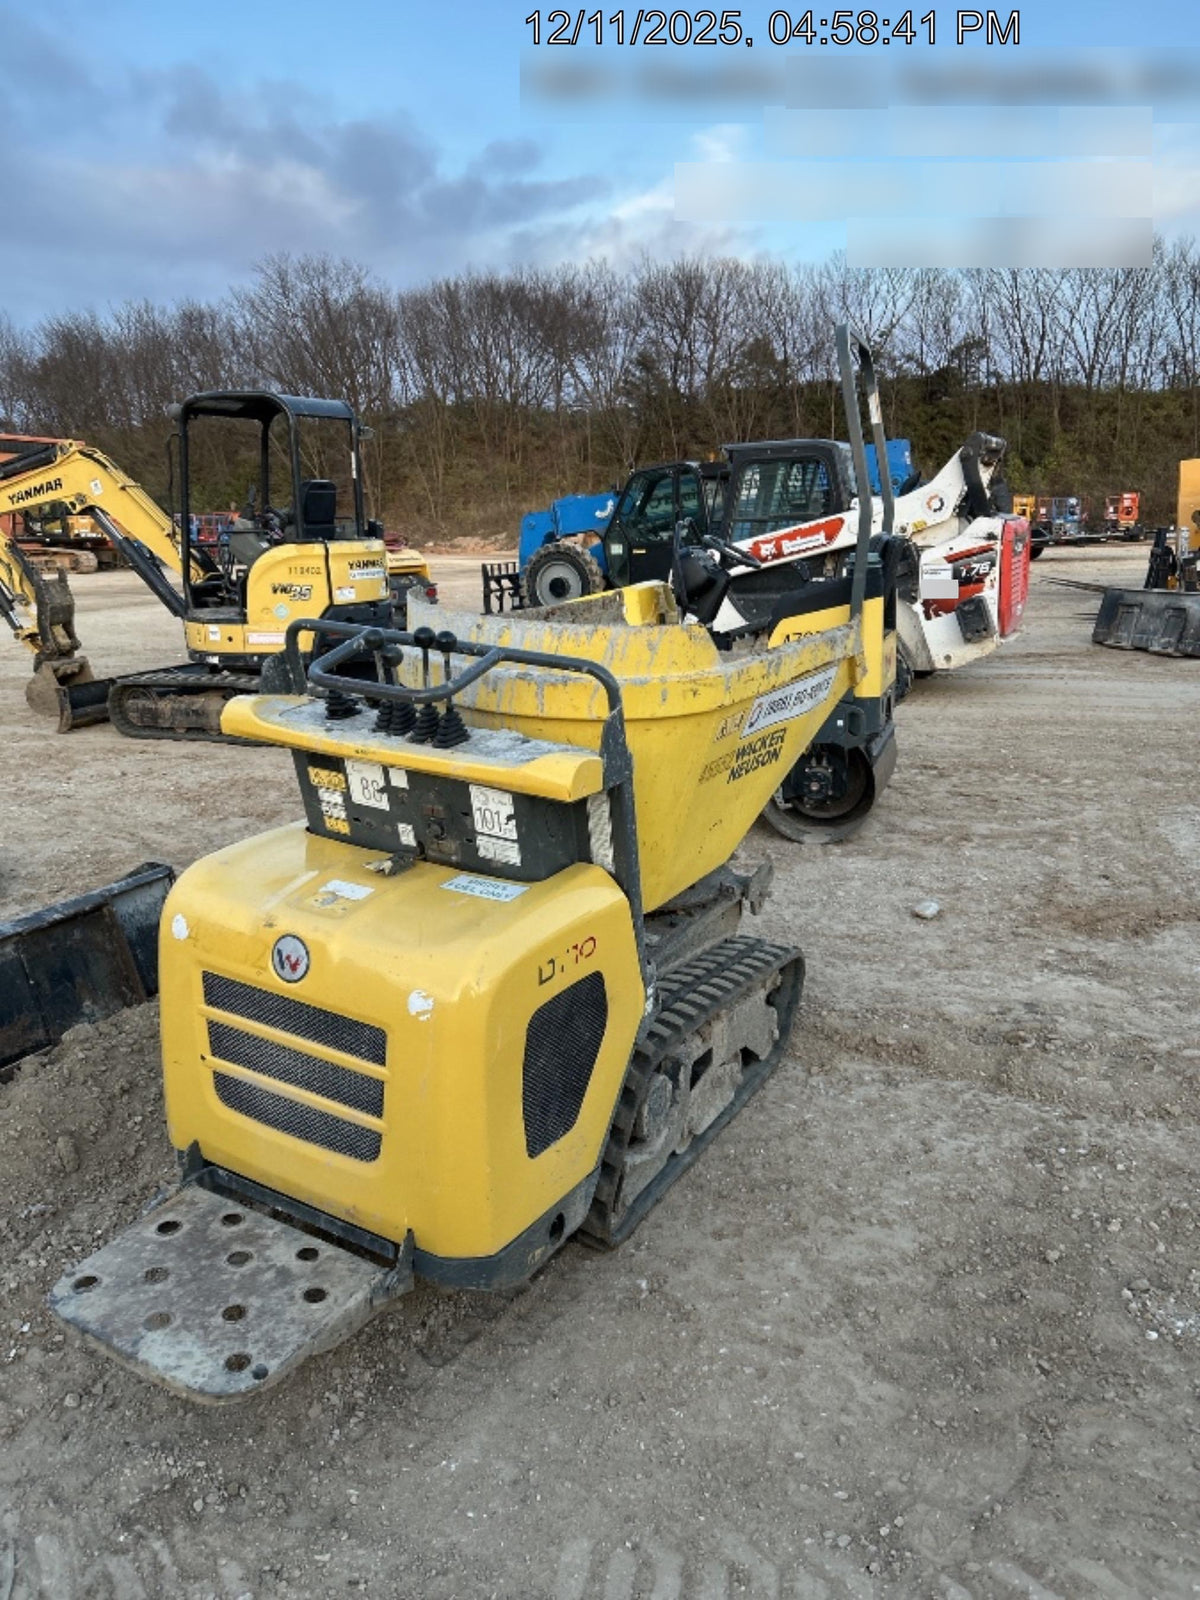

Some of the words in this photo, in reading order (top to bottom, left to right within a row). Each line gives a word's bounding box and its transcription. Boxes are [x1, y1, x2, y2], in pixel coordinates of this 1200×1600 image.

[8, 478, 63, 505] YANMAR
[735, 727, 788, 763] WACKER
[726, 745, 784, 784] NEUSON
